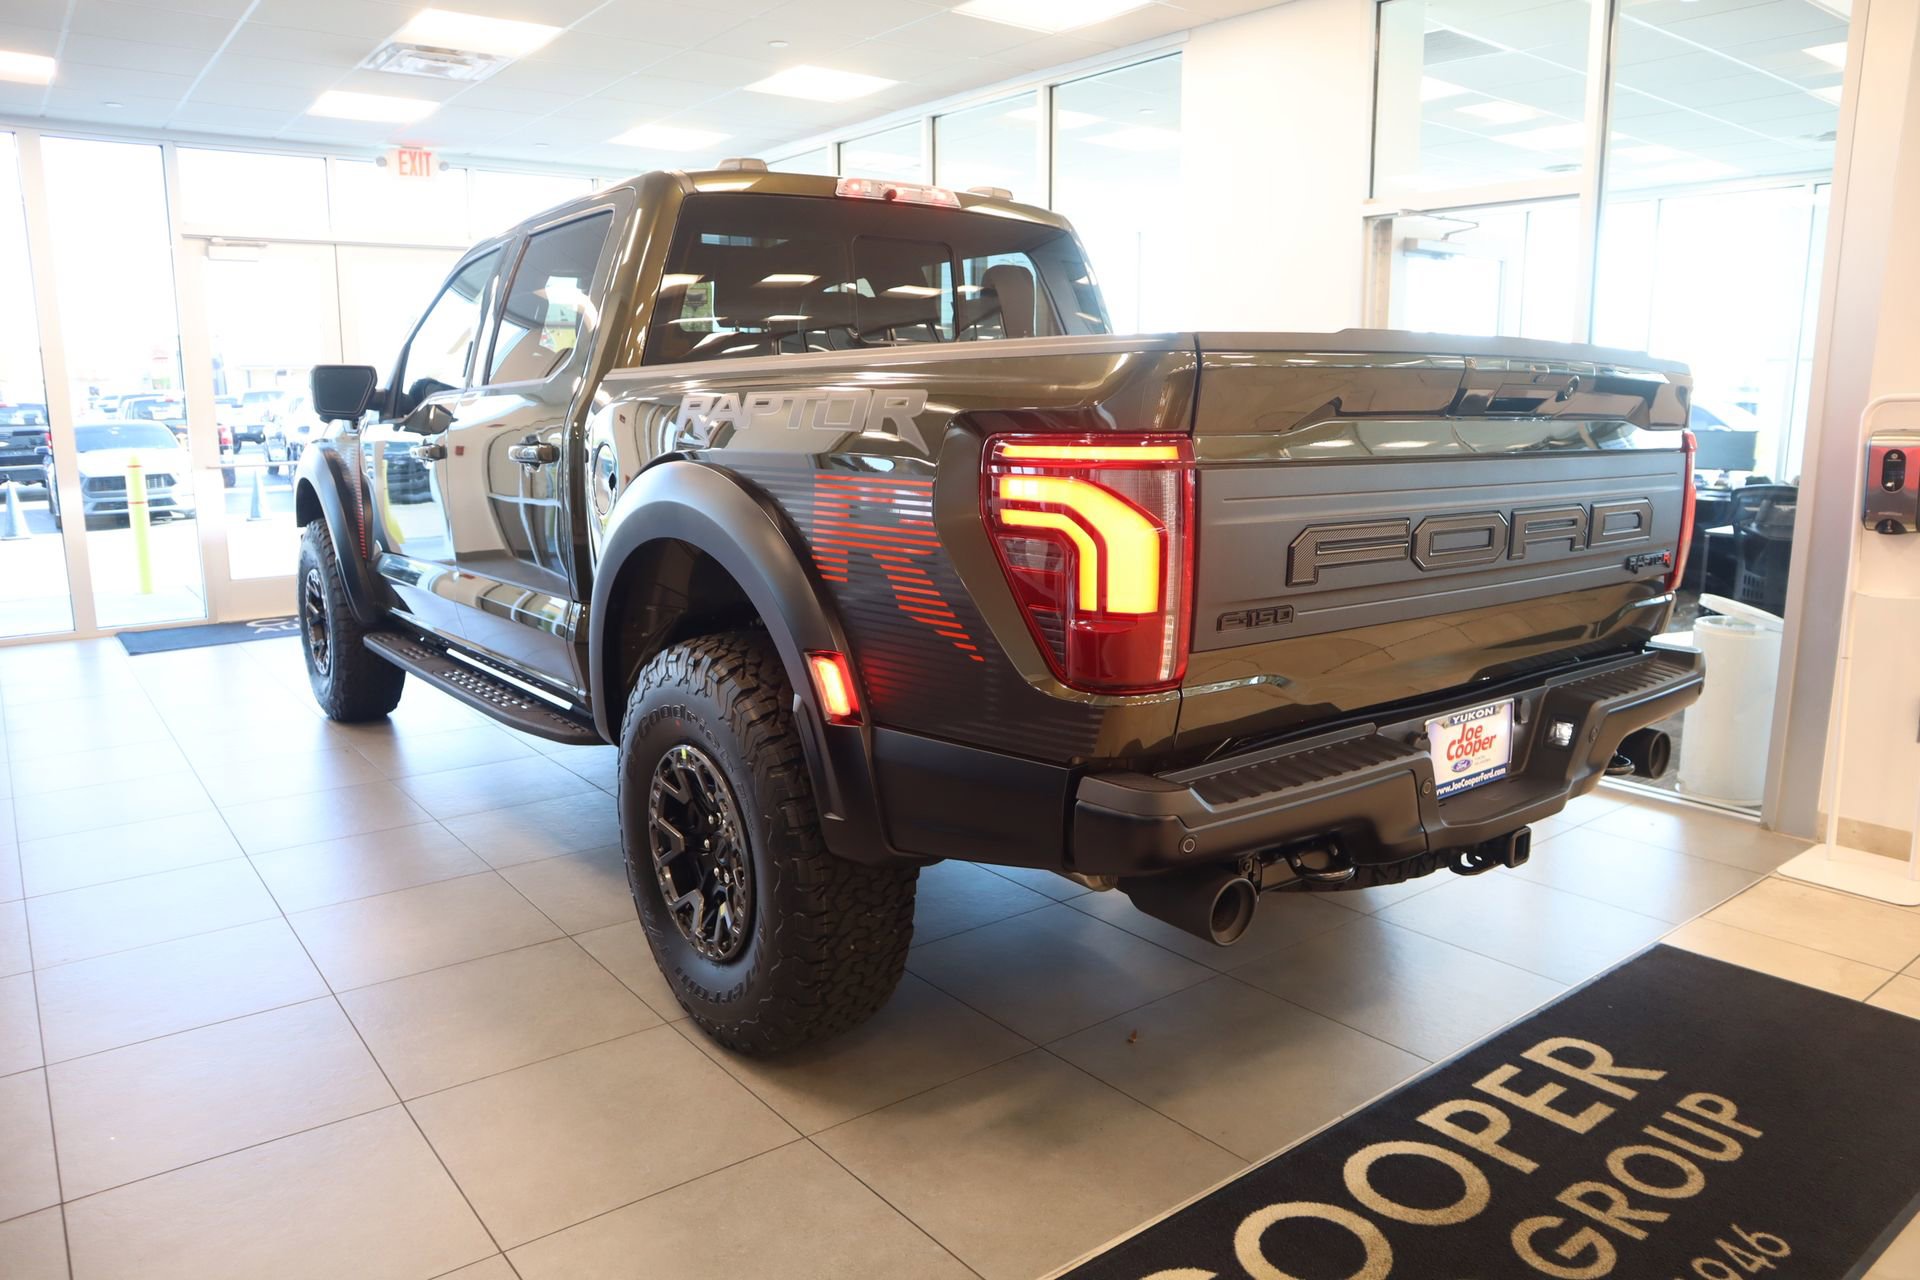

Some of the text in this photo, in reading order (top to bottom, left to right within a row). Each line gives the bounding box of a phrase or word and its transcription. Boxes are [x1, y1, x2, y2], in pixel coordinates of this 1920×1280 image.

[398, 149, 432, 177] EXIT
[674, 388, 929, 455] RAPTOR
[1286, 496, 1654, 587] FORD
[1452, 707, 1495, 724] YUKON
[1458, 723, 1483, 745] Joe
[1446, 735, 1496, 761] Cooper
[1141, 1036, 1667, 1280] OOPER
[1511, 1092, 1762, 1280] GROUP
[1674, 1223, 1792, 1280] 946
